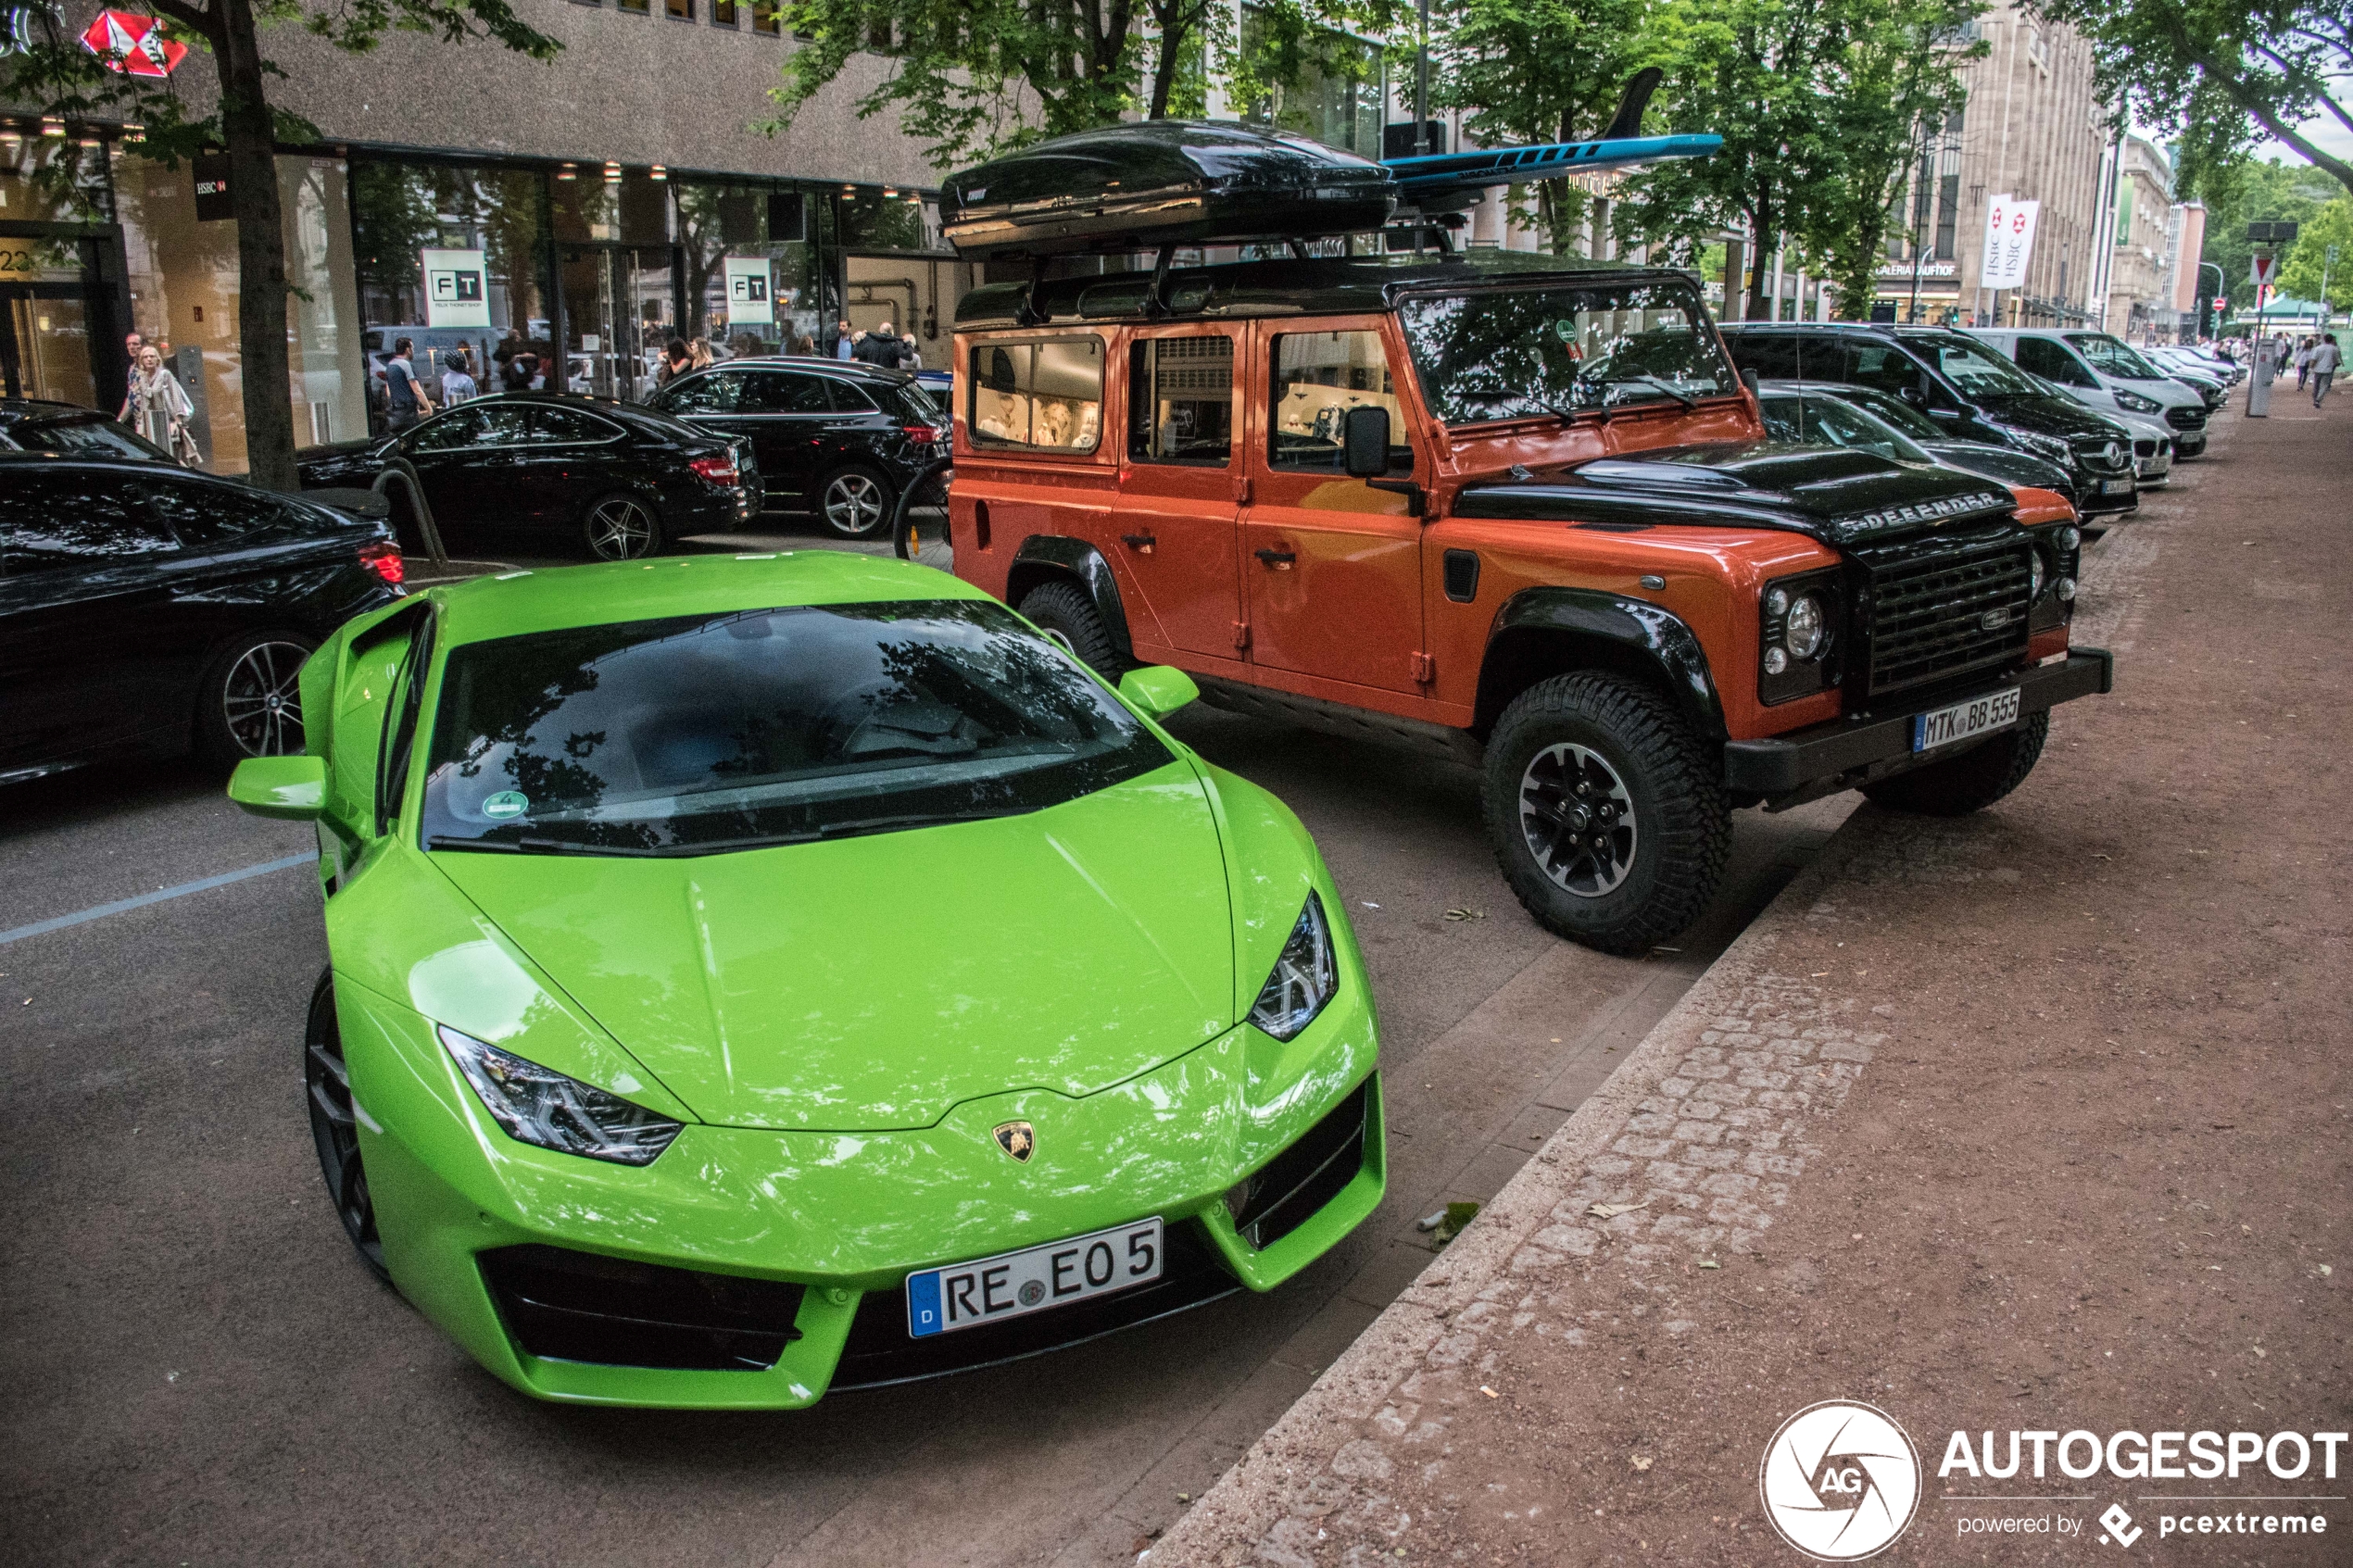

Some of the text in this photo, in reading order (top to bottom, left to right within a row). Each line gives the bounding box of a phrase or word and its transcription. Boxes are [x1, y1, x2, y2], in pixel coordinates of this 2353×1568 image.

[196, 182, 216, 194] HSBC
[1986, 234, 2000, 276] HSBC
[2005, 239, 2022, 277] HSBC
[1864, 492, 1994, 530] DEFENDER
[1925, 692, 2019, 744] MTK BB 555
[500, 793, 512, 804] 4
[946, 1264, 1014, 1322] RE
[1128, 1229, 1154, 1275] 5
[921, 1310, 933, 1323] D
